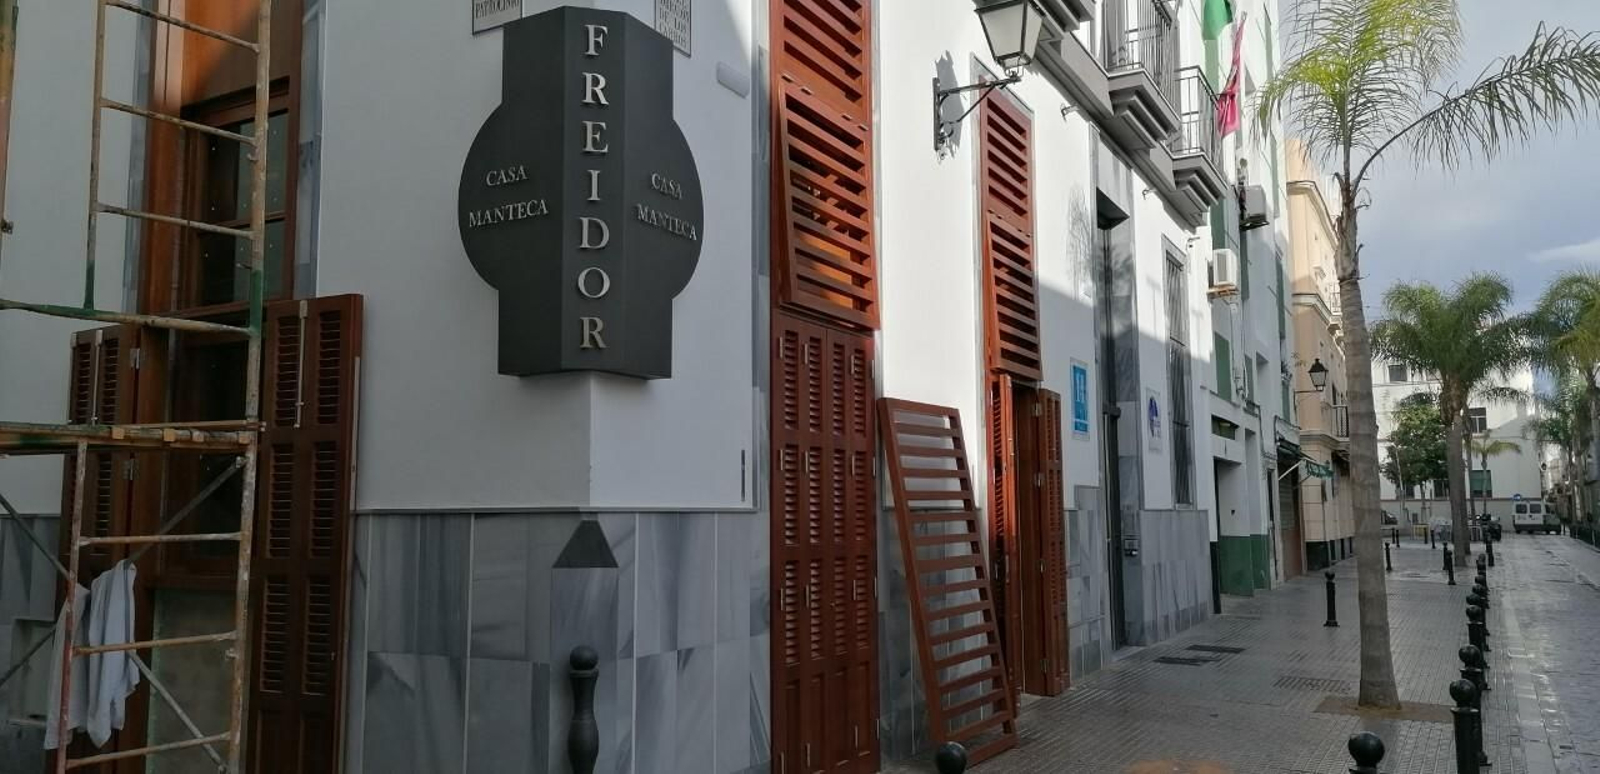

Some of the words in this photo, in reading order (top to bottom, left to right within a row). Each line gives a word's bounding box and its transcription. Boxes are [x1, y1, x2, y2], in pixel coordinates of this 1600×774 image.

[486, 165, 527, 186] CASA
[577, 24, 610, 349] FREIDOR
[651, 173, 682, 199] CASA
[469, 199, 548, 227] MANTECA
[637, 203, 697, 241] MANTECA
